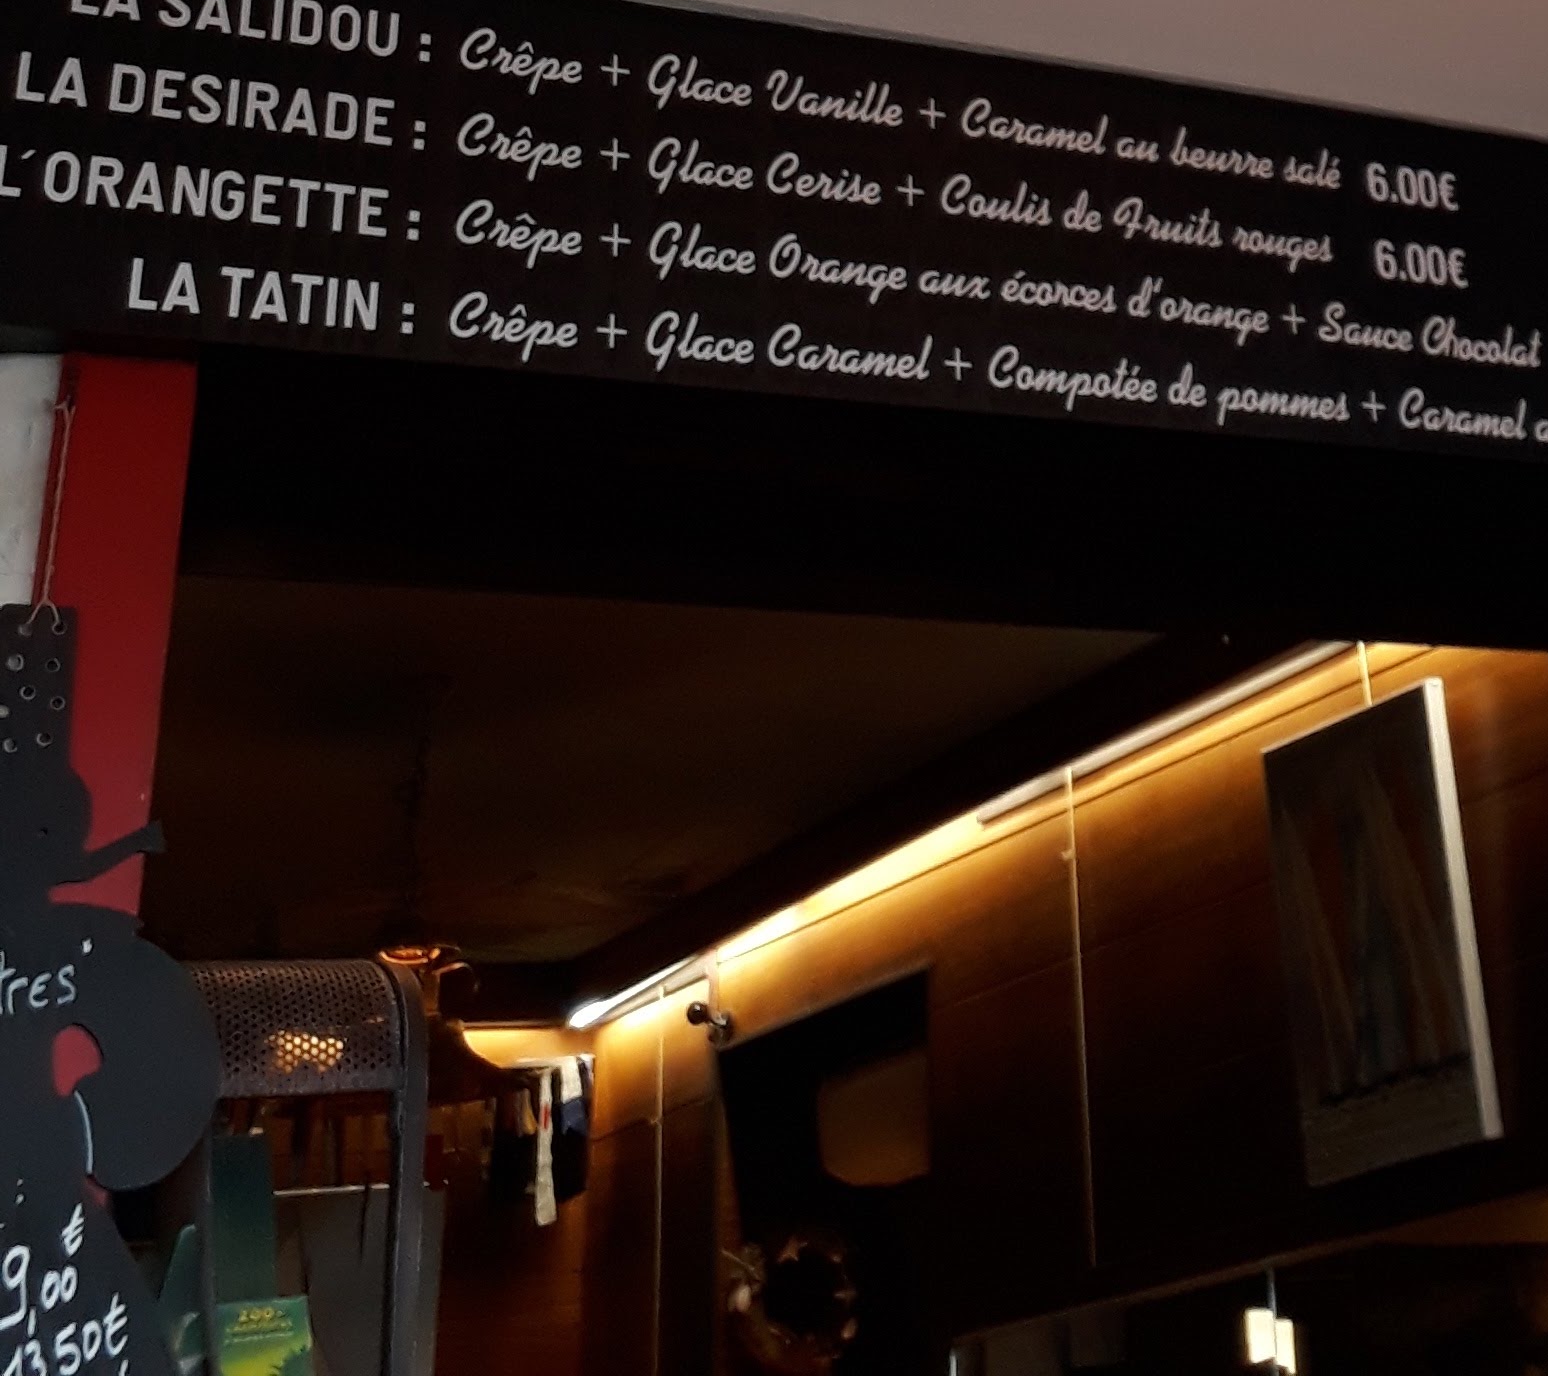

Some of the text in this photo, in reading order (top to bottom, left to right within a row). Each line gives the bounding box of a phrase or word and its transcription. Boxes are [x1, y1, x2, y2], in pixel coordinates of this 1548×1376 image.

[15, 51, 88, 108] LA
[108, 63, 395, 146] DESIRADE
[457, 112, 583, 182] Crêpe
[648, 137, 754, 194] Glace
[766, 151, 882, 205] Cerise
[940, 173, 1053, 227] Coulis
[1063, 189, 1103, 233] de
[1113, 196, 1223, 248] Fruits
[1232, 226, 1334, 273] rouges
[1374, 238, 1469, 289] 6.00€
[459, 27, 583, 95] Crêpe
[647, 53, 752, 110] Glace
[767, 69, 903, 127] Vanille
[961, 97, 1109, 156] Caramel
[1116, 135, 1160, 164] au
[1170, 126, 1274, 180] beurre
[1283, 148, 1341, 190] salé
[1366, 161, 1460, 212] 6.00€
[127, 257, 200, 315] LA
[221, 266, 380, 331] TATIN
[449, 291, 578, 363] Crêpe
[645, 310, 755, 372] Glace
[767, 323, 933, 380] Caramel
[988, 344, 1158, 412] Compotée
[1168, 361, 1208, 408] de
[1216, 382, 1350, 426] pommes
[1399, 387, 1527, 441] Caramel
[455, 199, 583, 269] Crêpe
[649, 220, 757, 281] Glace
[768, 233, 907, 305] Orange
[918, 267, 992, 300] aux
[1000, 269, 1117, 314] écorces
[1127, 275, 1271, 348] d'orange
[1317, 300, 1414, 352] Sauce
[1421, 314, 1542, 369] Chocolat
